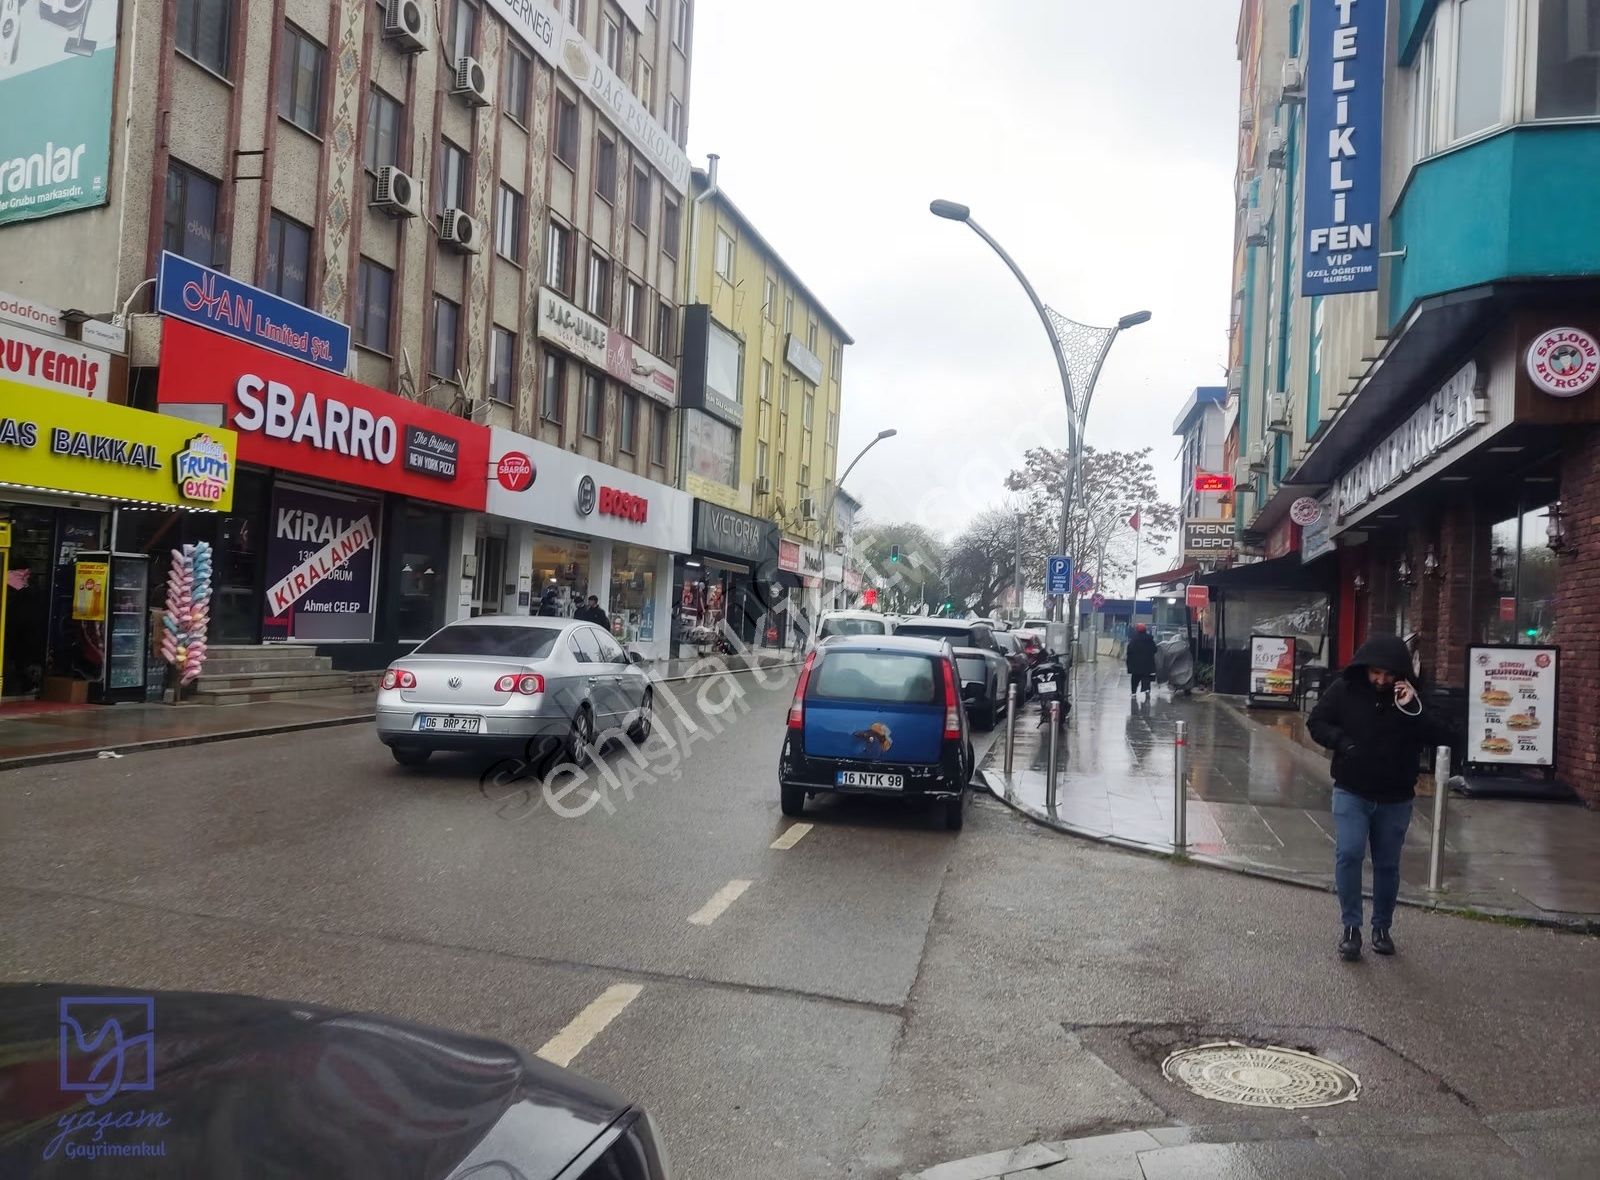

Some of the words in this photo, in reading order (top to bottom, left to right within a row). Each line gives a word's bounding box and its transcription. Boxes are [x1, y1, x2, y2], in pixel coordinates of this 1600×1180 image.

[10, 195, 36, 208] Grubu
[1310, 223, 1372, 252] FEN
[1327, 254, 1352, 266] VIP
[1323, 275, 1355, 283] KURSU
[255, 314, 309, 352] Limited
[311, 336, 333, 361] Şti.
[1537, 333, 1596, 357] SALOON
[1536, 361, 1597, 388] BURGER
[234, 374, 397, 464] SBARRO
[52, 427, 163, 471] BAKKAL
[414, 431, 428, 446] The
[428, 435, 456, 453] Original
[410, 452, 424, 468] NEW
[424, 456, 439, 472] YORK
[439, 460, 455, 476] PIZZA
[499, 465, 530, 474] SBARRO
[186, 480, 220, 500] extra
[599, 486, 648, 524] BOSCH
[1192, 538, 1233, 548] DEPO
[1056, 561, 1064, 573] P
[304, 600, 332, 612] Ahmet
[334, 602, 360, 613] CELEP
[426, 718, 437, 728] 06
[443, 719, 459, 729] BRP
[461, 720, 478, 730] 217
[844, 773, 855, 784] 16
[859, 774, 884, 786] NTK
[888, 776, 902, 787] 98
